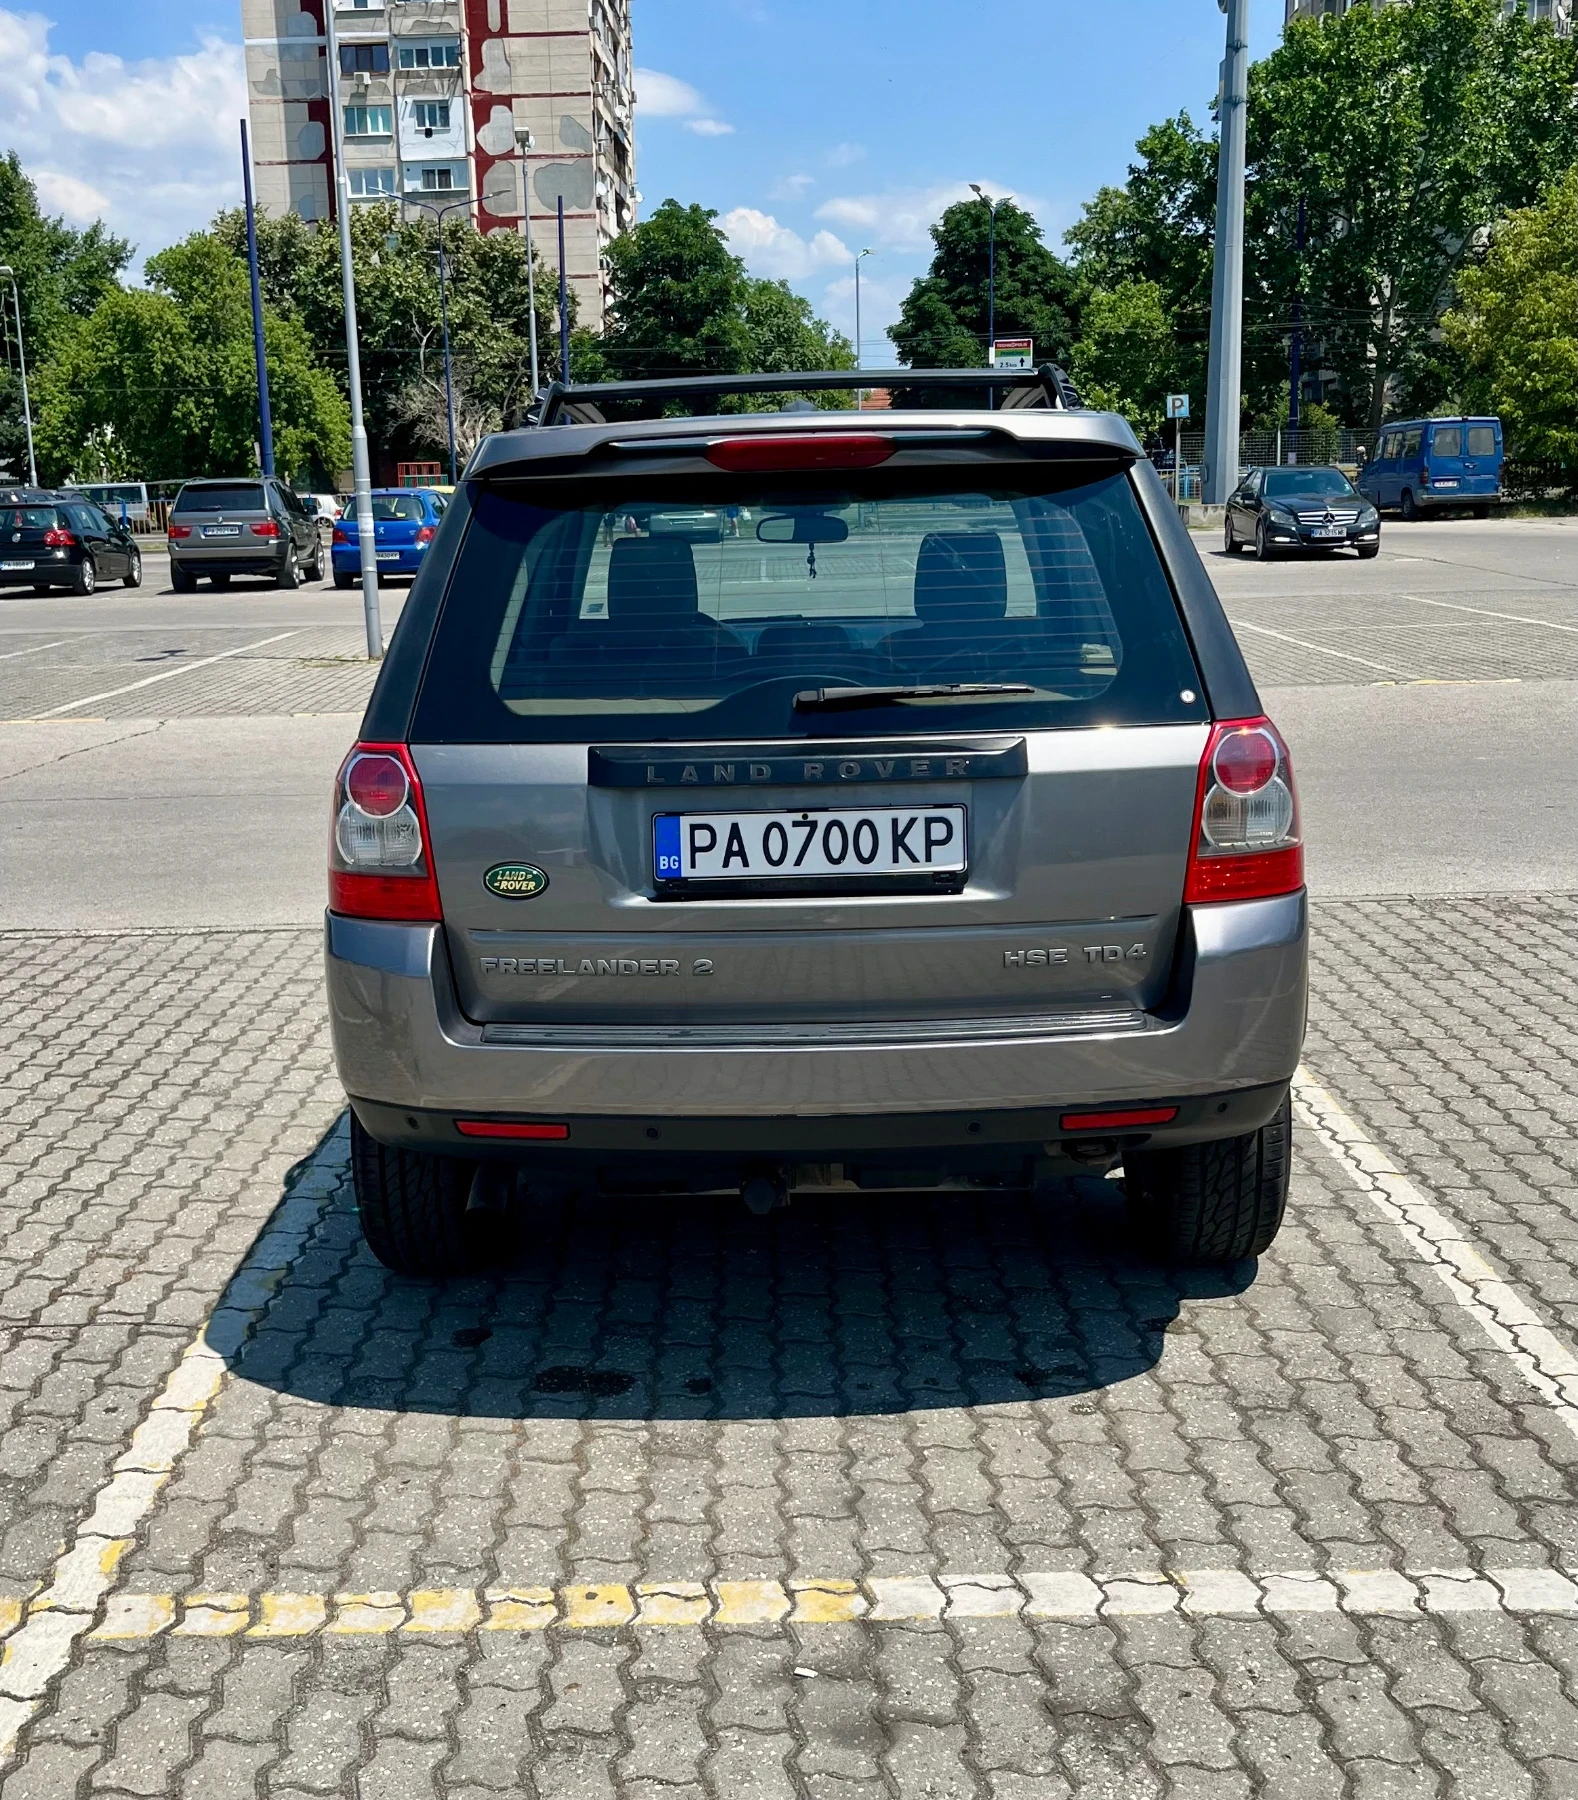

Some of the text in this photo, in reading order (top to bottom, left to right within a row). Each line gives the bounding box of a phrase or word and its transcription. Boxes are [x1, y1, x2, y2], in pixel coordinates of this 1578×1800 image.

[1171, 397, 1184, 417] P
[646, 758, 968, 783] LAND ROVER
[689, 816, 954, 870] PA 0700 KP
[659, 855, 680, 870] BG
[497, 870, 526, 881] LAND
[500, 880, 536, 890] ROVER
[1004, 943, 1147, 968] HSE TD4
[480, 957, 714, 977] FREELANDER 2
